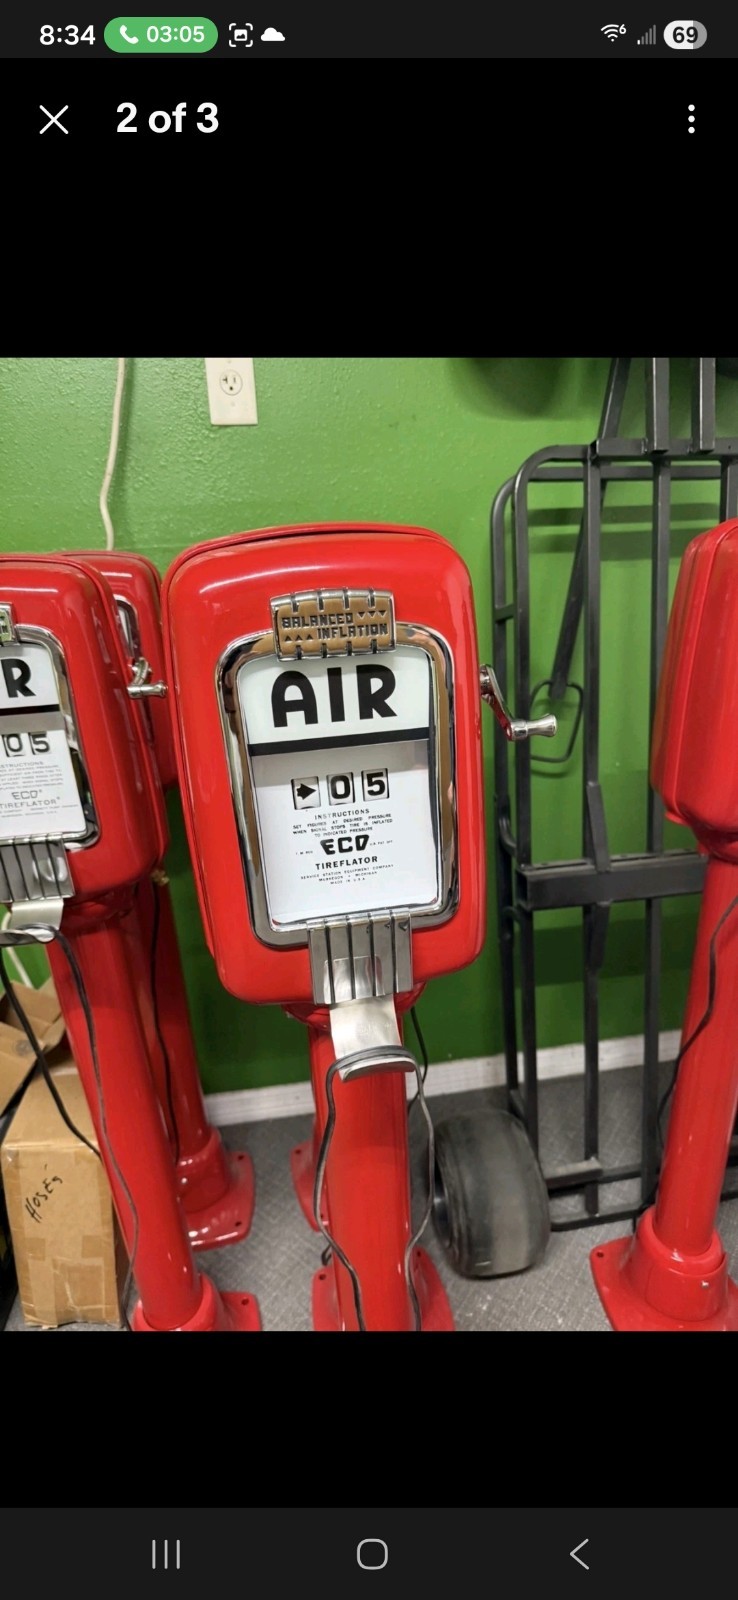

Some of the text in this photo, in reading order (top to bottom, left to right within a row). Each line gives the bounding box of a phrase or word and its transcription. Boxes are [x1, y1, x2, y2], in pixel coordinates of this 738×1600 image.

[281, 612, 354, 629] BALANCED
[317, 623, 389, 640] INFLATION
[271, 663, 398, 728] AIR
[314, 808, 370, 820] INSTRUCTIONS
[319, 834, 370, 856] ECO
[315, 855, 378, 870] TIREFLATOR
